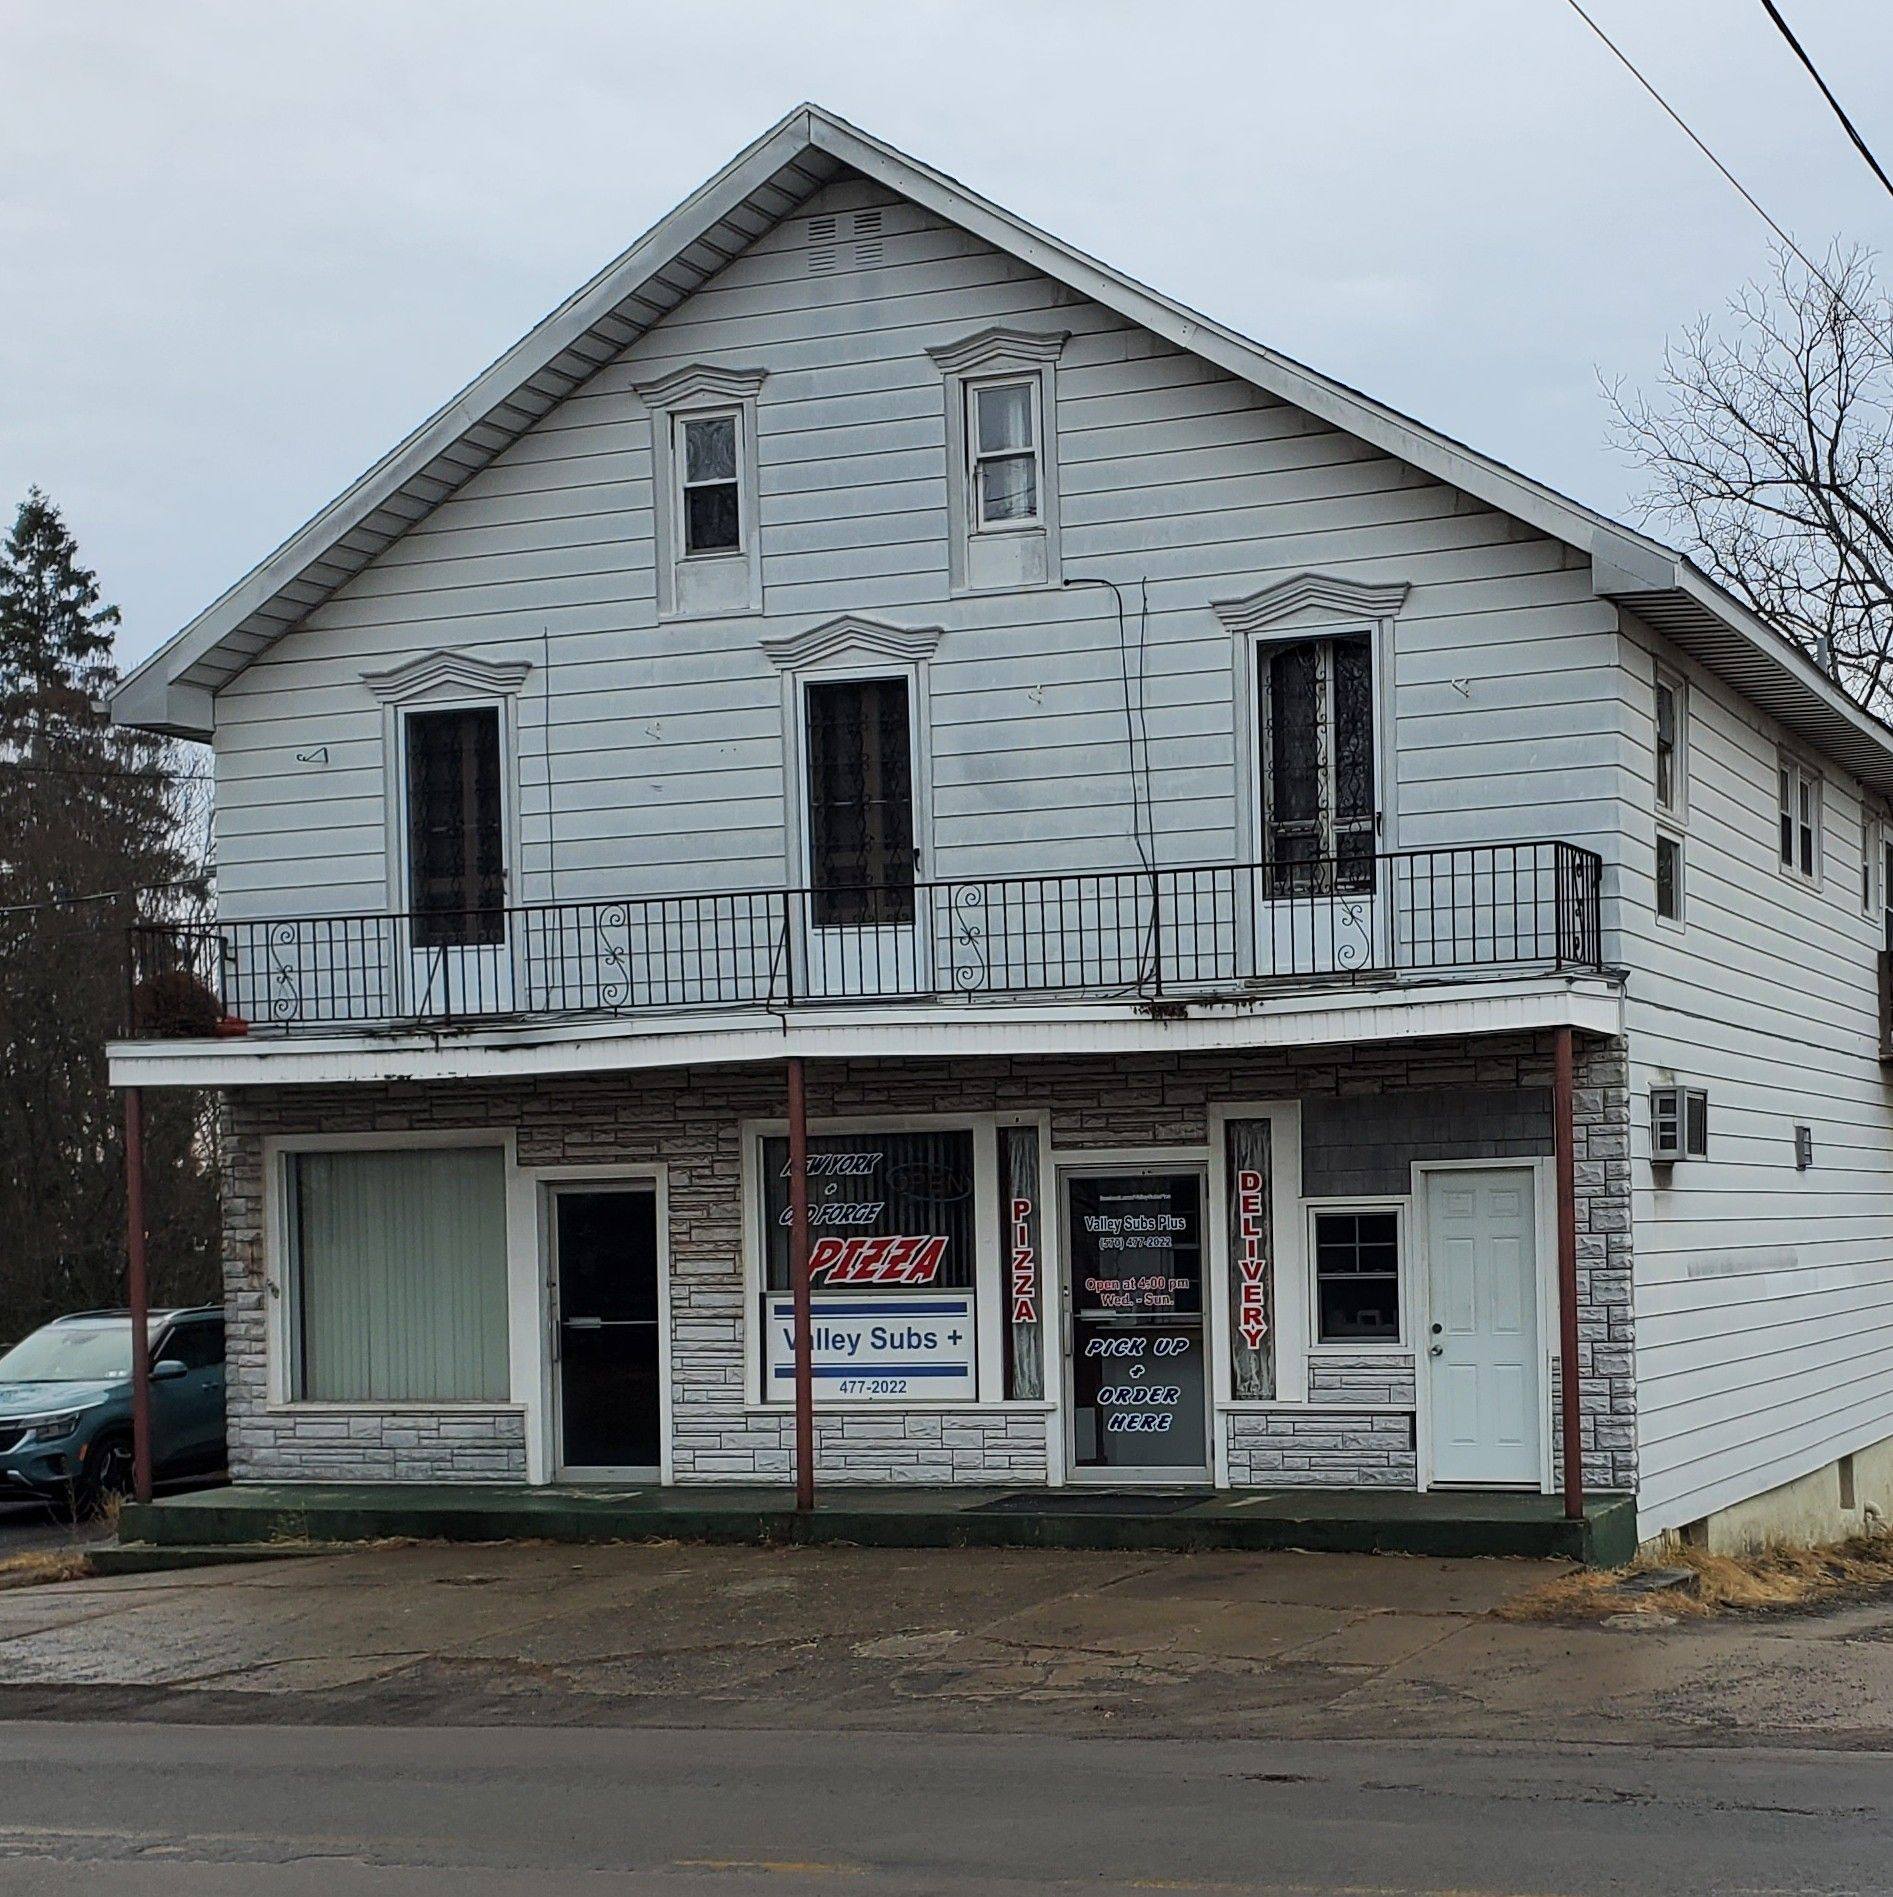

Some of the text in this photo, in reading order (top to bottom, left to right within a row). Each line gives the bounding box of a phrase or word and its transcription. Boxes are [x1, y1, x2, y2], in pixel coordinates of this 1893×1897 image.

[826, 1153, 883, 1175] YORK
[779, 1202, 885, 1226] OD FORGE
[1084, 1214, 1186, 1234] Valley Subs Plus
[1126, 1236, 1172, 1248] 477-2022
[810, 1235, 949, 1283] PIZZA
[1012, 1198, 1037, 1323] PIZZA
[1238, 1170, 1267, 1349] DELIVERY
[1085, 1276, 1190, 1292] Open at 4:00 pm
[1101, 1293, 1134, 1307] Wed.
[1144, 1293, 1175, 1306] Sun.
[783, 1327, 962, 1356] Vlley Subs +
[1085, 1337, 1190, 1357] PICK UP
[840, 1381, 907, 1394] 477-2022
[1097, 1386, 1180, 1405] ORDER
[1107, 1412, 1172, 1432] HERE
